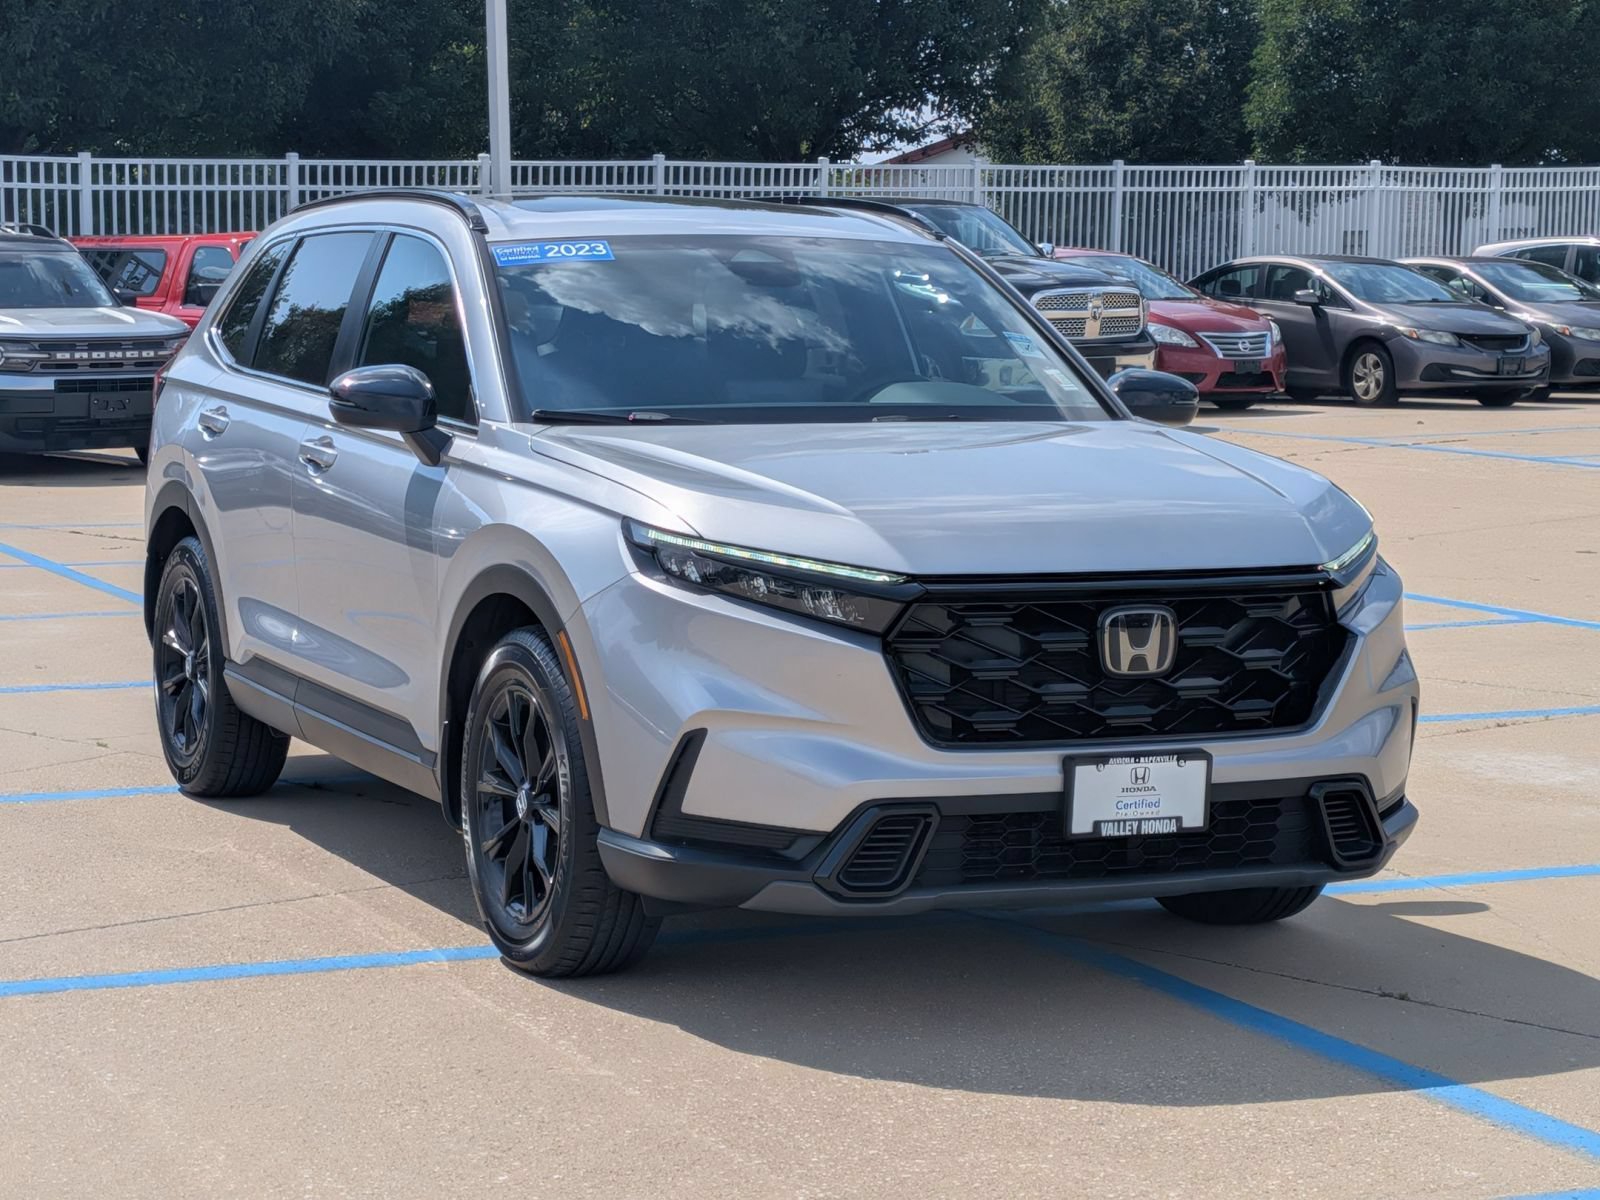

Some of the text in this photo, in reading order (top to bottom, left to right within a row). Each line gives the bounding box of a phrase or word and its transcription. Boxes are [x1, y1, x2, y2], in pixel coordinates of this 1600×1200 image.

[544, 243, 607, 257] 2023
[56, 350, 155, 359] BRONCO
[1121, 785, 1157, 793] HONDA
[1115, 797, 1161, 810] Certified
[1115, 809, 1161, 817] Pre-Owned
[1101, 818, 1177, 837] VALLEY HONDA
